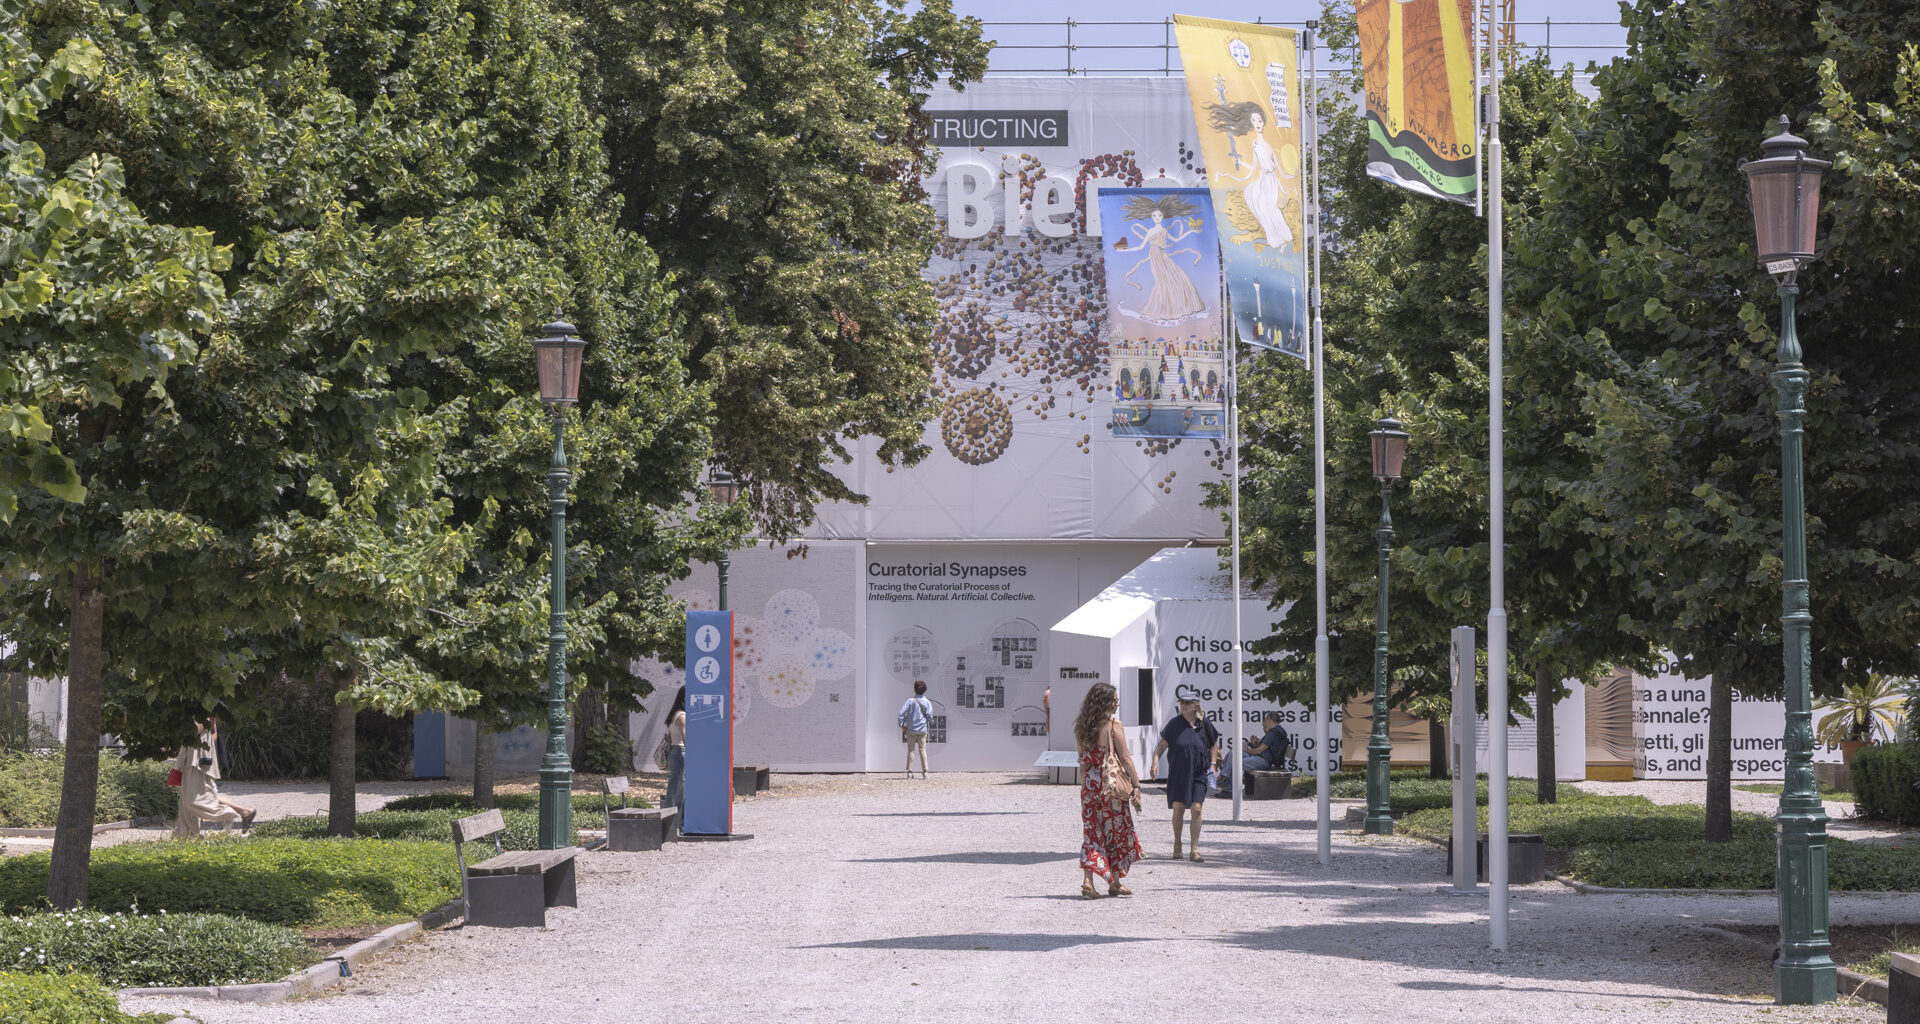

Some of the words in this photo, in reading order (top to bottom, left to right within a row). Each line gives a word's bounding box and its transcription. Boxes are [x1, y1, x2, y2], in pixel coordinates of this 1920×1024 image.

[1271, 97, 1286, 105] PACE
[1256, 255, 1294, 274] JUSTICE
[868, 562, 946, 577] Curatorial
[949, 562, 1027, 579] Synapses
[868, 582, 901, 592] Tracing
[902, 582, 917, 591] the
[918, 582, 963, 591] Curatorial
[963, 582, 1000, 591] Process
[1001, 582, 1011, 591] of
[868, 592, 914, 602] Intelligens.
[916, 592, 949, 601] Natural.
[951, 592, 988, 601] Artificial.
[990, 592, 1036, 601] Collective.
[1175, 635, 1206, 652] Chi
[1175, 657, 1219, 674] Who
[1060, 670, 1067, 679] la
[1068, 670, 1100, 679] Biennale
[1656, 689, 1667, 702] a
[1671, 689, 1705, 702] una
[1300, 710, 1310, 723] a
[1682, 733, 1704, 753] gli
[1666, 755, 1701, 771] and
